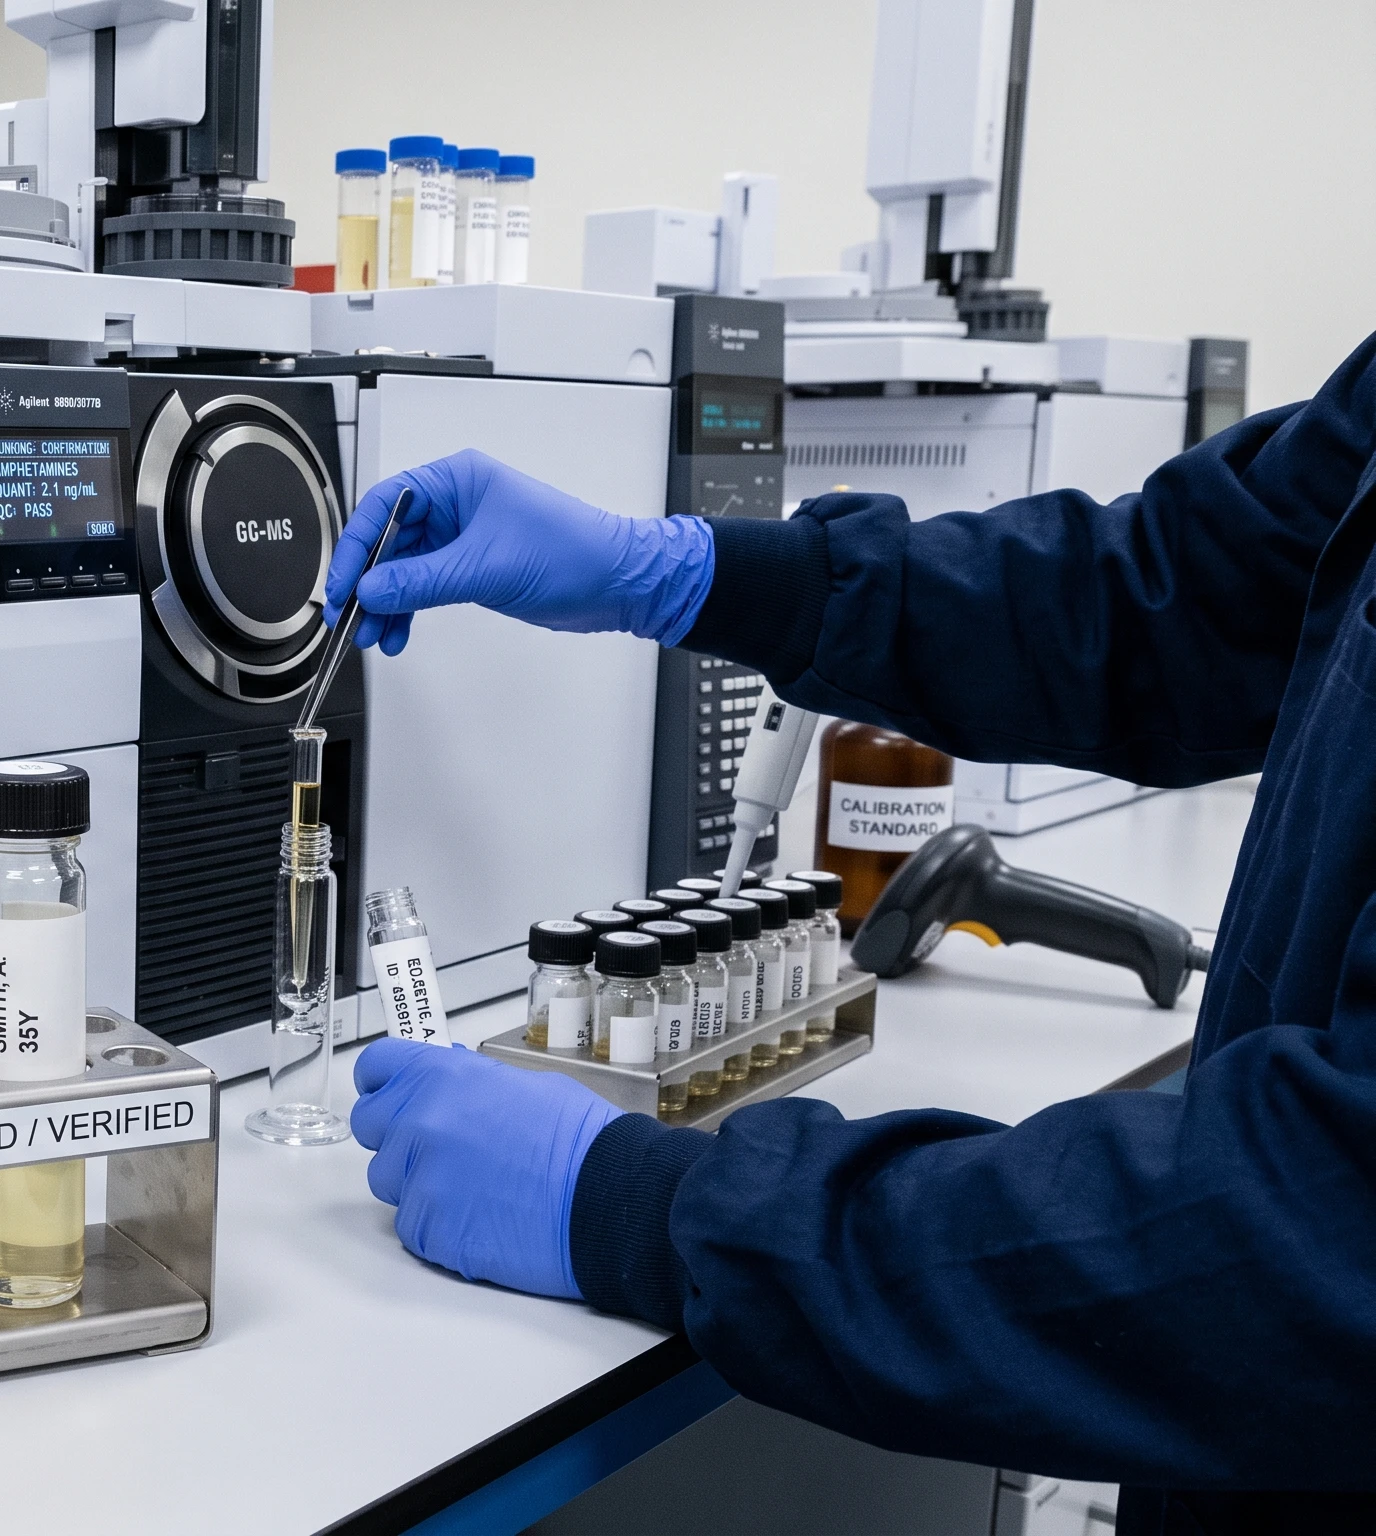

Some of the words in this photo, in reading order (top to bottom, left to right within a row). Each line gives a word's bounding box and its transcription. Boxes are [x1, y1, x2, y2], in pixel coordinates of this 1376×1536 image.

[19, 395, 50, 409] Agilent
[41, 482, 59, 497] 2.1
[64, 481, 98, 501] ng/mL
[24, 502, 53, 518] PASS
[235, 517, 293, 543] GC-MS
[841, 798, 945, 816] CALIBRATION
[849, 819, 939, 837] STANDARD
[18, 1009, 39, 1053] 35Y
[27, 1118, 38, 1147] /
[47, 1101, 194, 1143] VERIFIED
